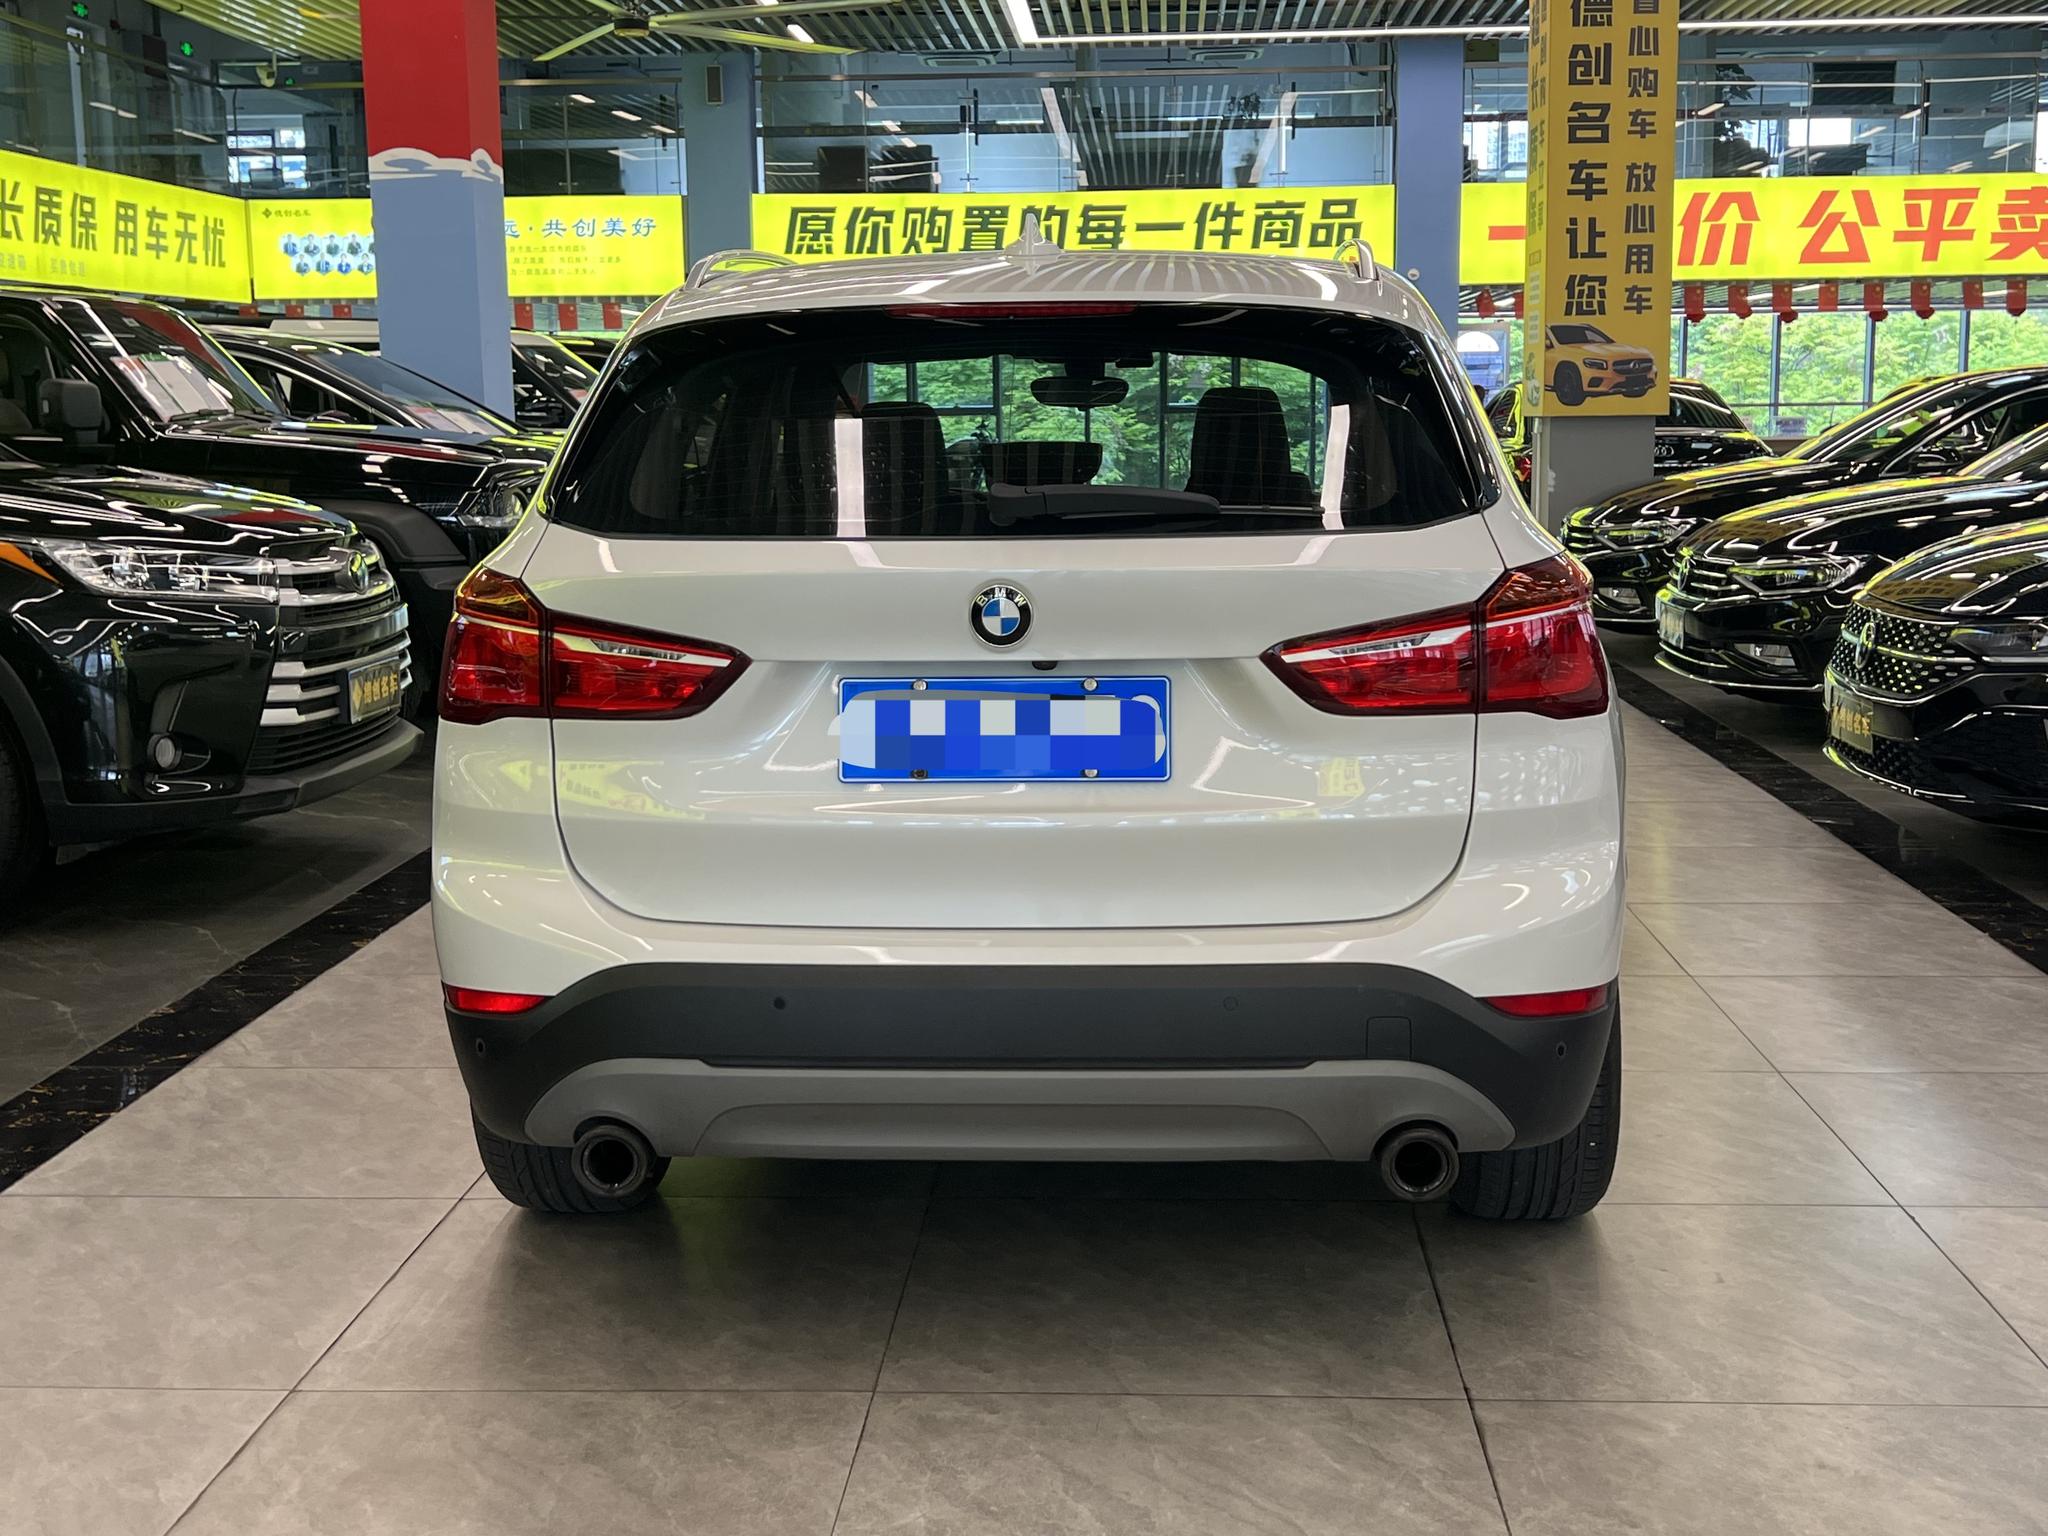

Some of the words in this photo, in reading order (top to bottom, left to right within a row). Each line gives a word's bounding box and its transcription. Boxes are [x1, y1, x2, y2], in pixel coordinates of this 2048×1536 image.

[1564, 0, 1613, 317] 德创名车让您
[0, 178, 98, 251] 长质保
[113, 199, 227, 268] 用车无忧
[784, 198, 1364, 254] 愿你购置的每一件商品
[1623, 161, 1657, 315] 放心用车
[975, 587, 1027, 607] BMW
